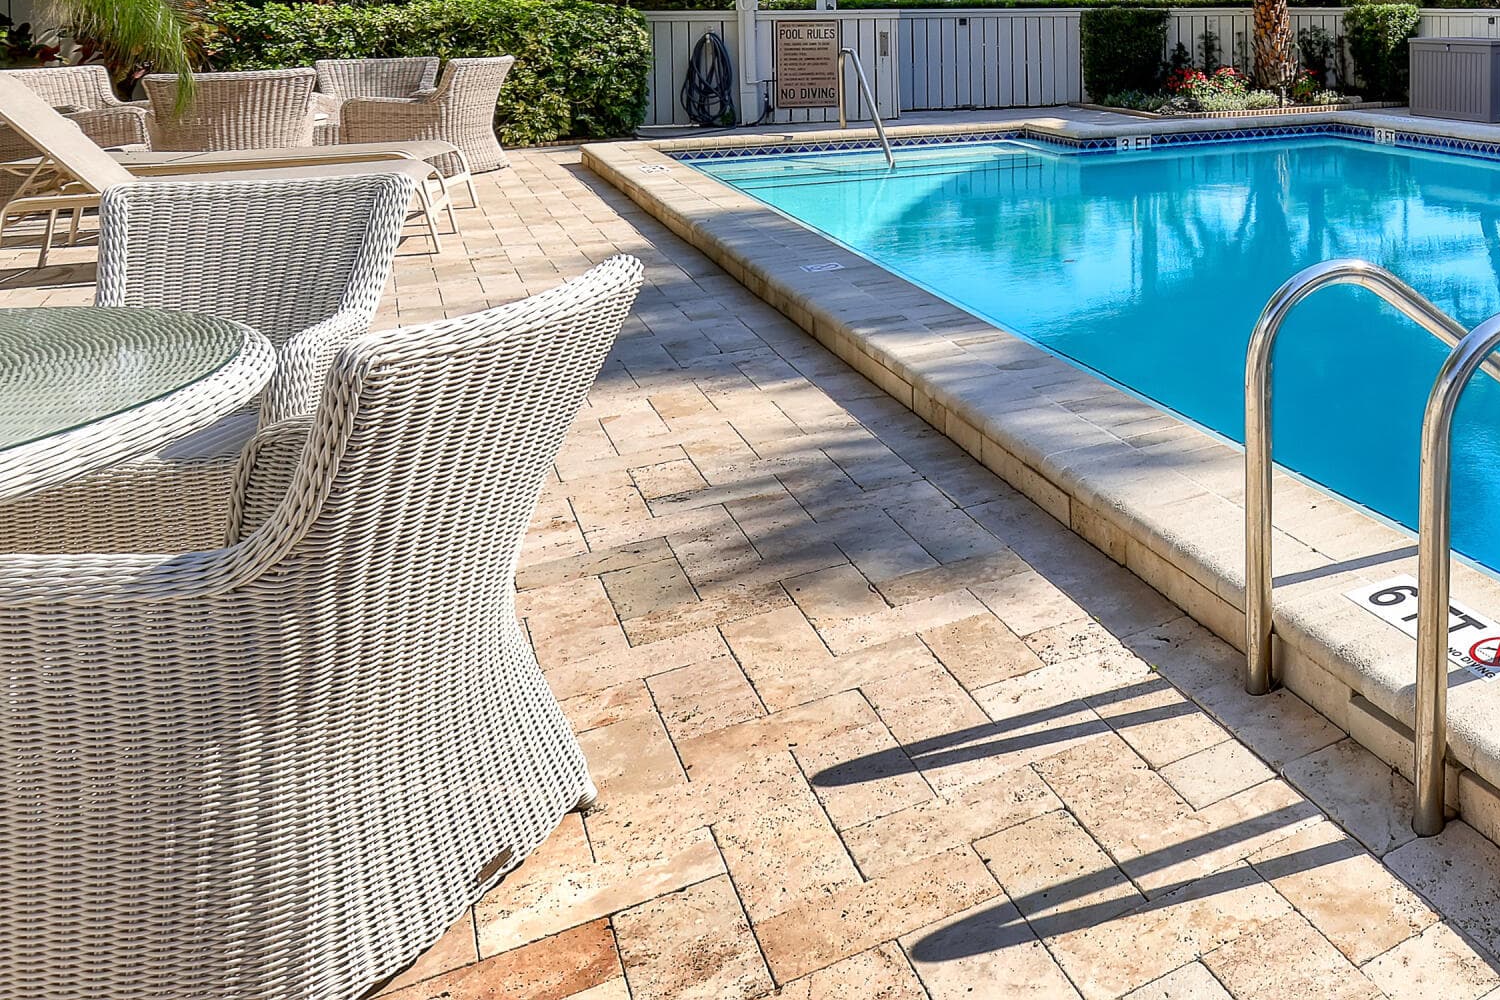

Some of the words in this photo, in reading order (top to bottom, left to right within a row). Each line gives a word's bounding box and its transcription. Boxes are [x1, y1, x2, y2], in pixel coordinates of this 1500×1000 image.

[779, 29, 803, 39] POOL
[807, 29, 835, 39] RULES
[781, 88, 796, 99] NO
[800, 87, 835, 99] DIVING
[1377, 129, 1383, 142] 3
[1121, 138, 1130, 151] 3
[1368, 585, 1418, 606] 6
[1448, 646, 1463, 657] NO
[1460, 656, 1496, 678] DIVING
